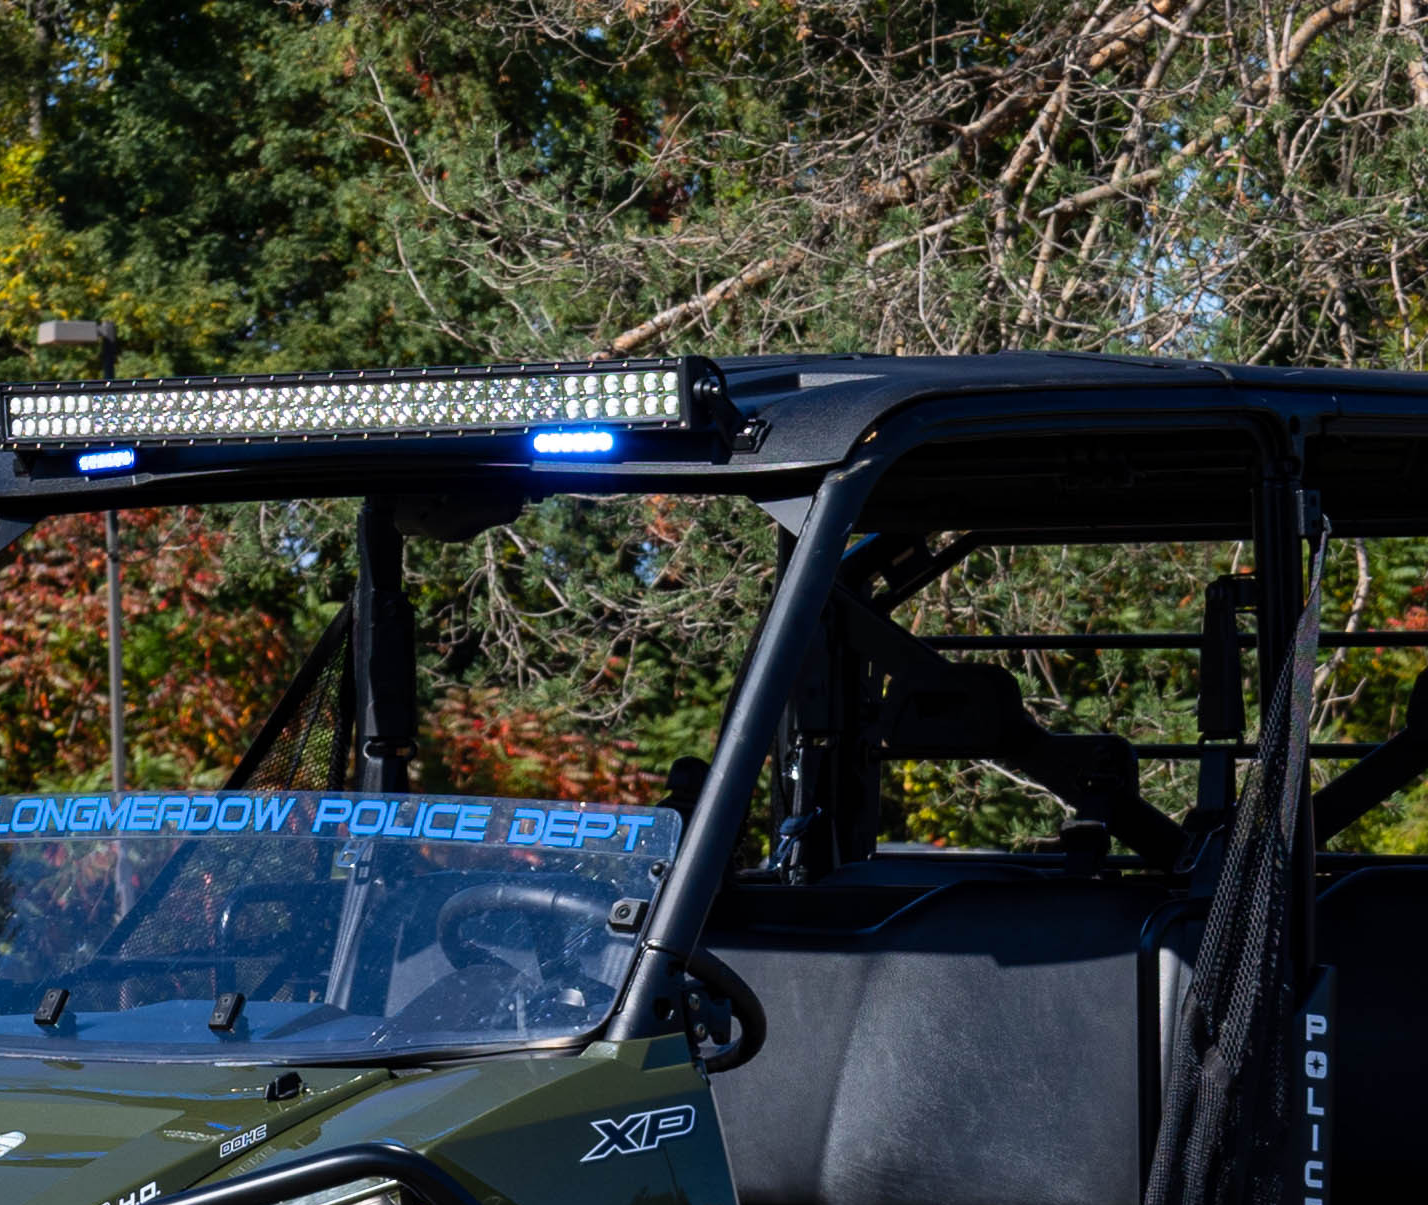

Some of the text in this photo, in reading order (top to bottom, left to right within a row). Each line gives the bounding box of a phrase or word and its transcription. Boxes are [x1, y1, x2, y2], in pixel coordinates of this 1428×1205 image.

[312, 798, 490, 841] POLICE
[507, 807, 654, 852] DEPT
[220, 1124, 267, 1158] DOHC
[579, 1104, 695, 1162] XP
